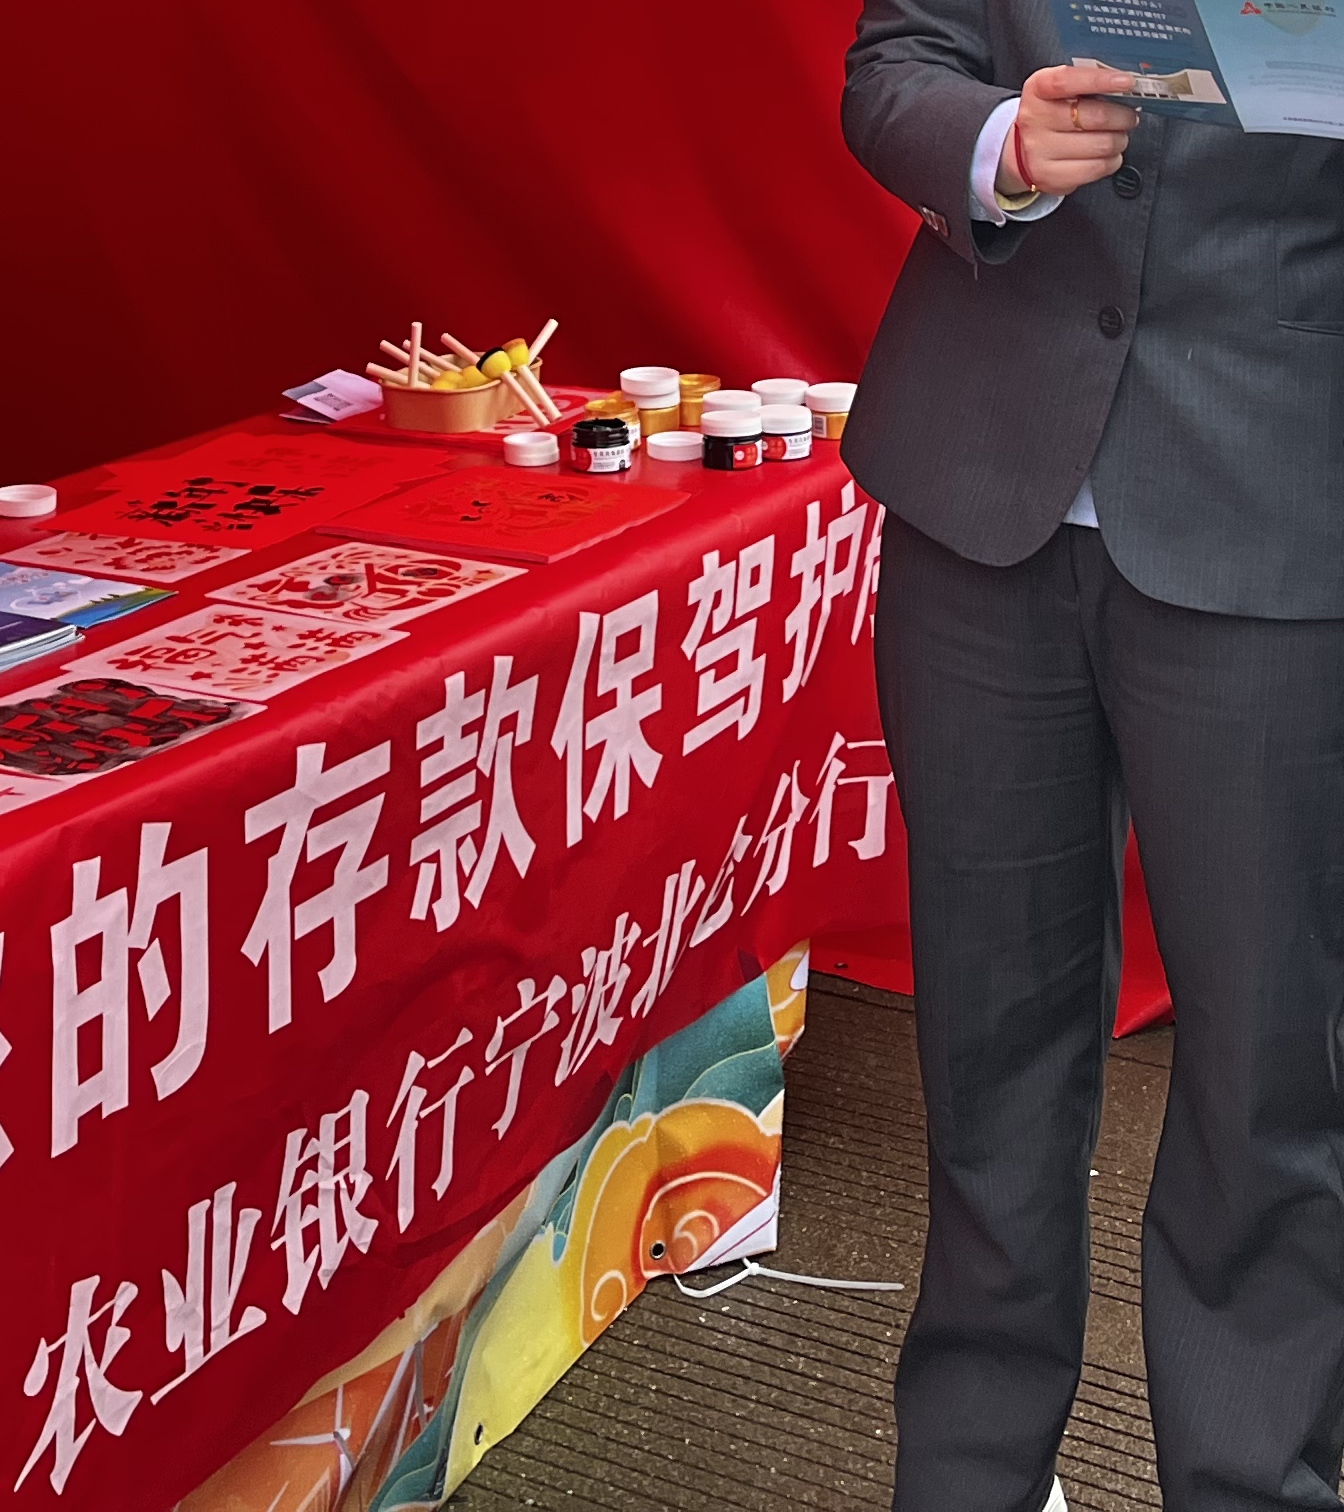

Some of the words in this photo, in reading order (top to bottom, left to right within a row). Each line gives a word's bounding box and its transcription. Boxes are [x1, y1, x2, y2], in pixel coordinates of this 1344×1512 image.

[14, 731, 895, 1495] 农业银行宁波北仑分行
